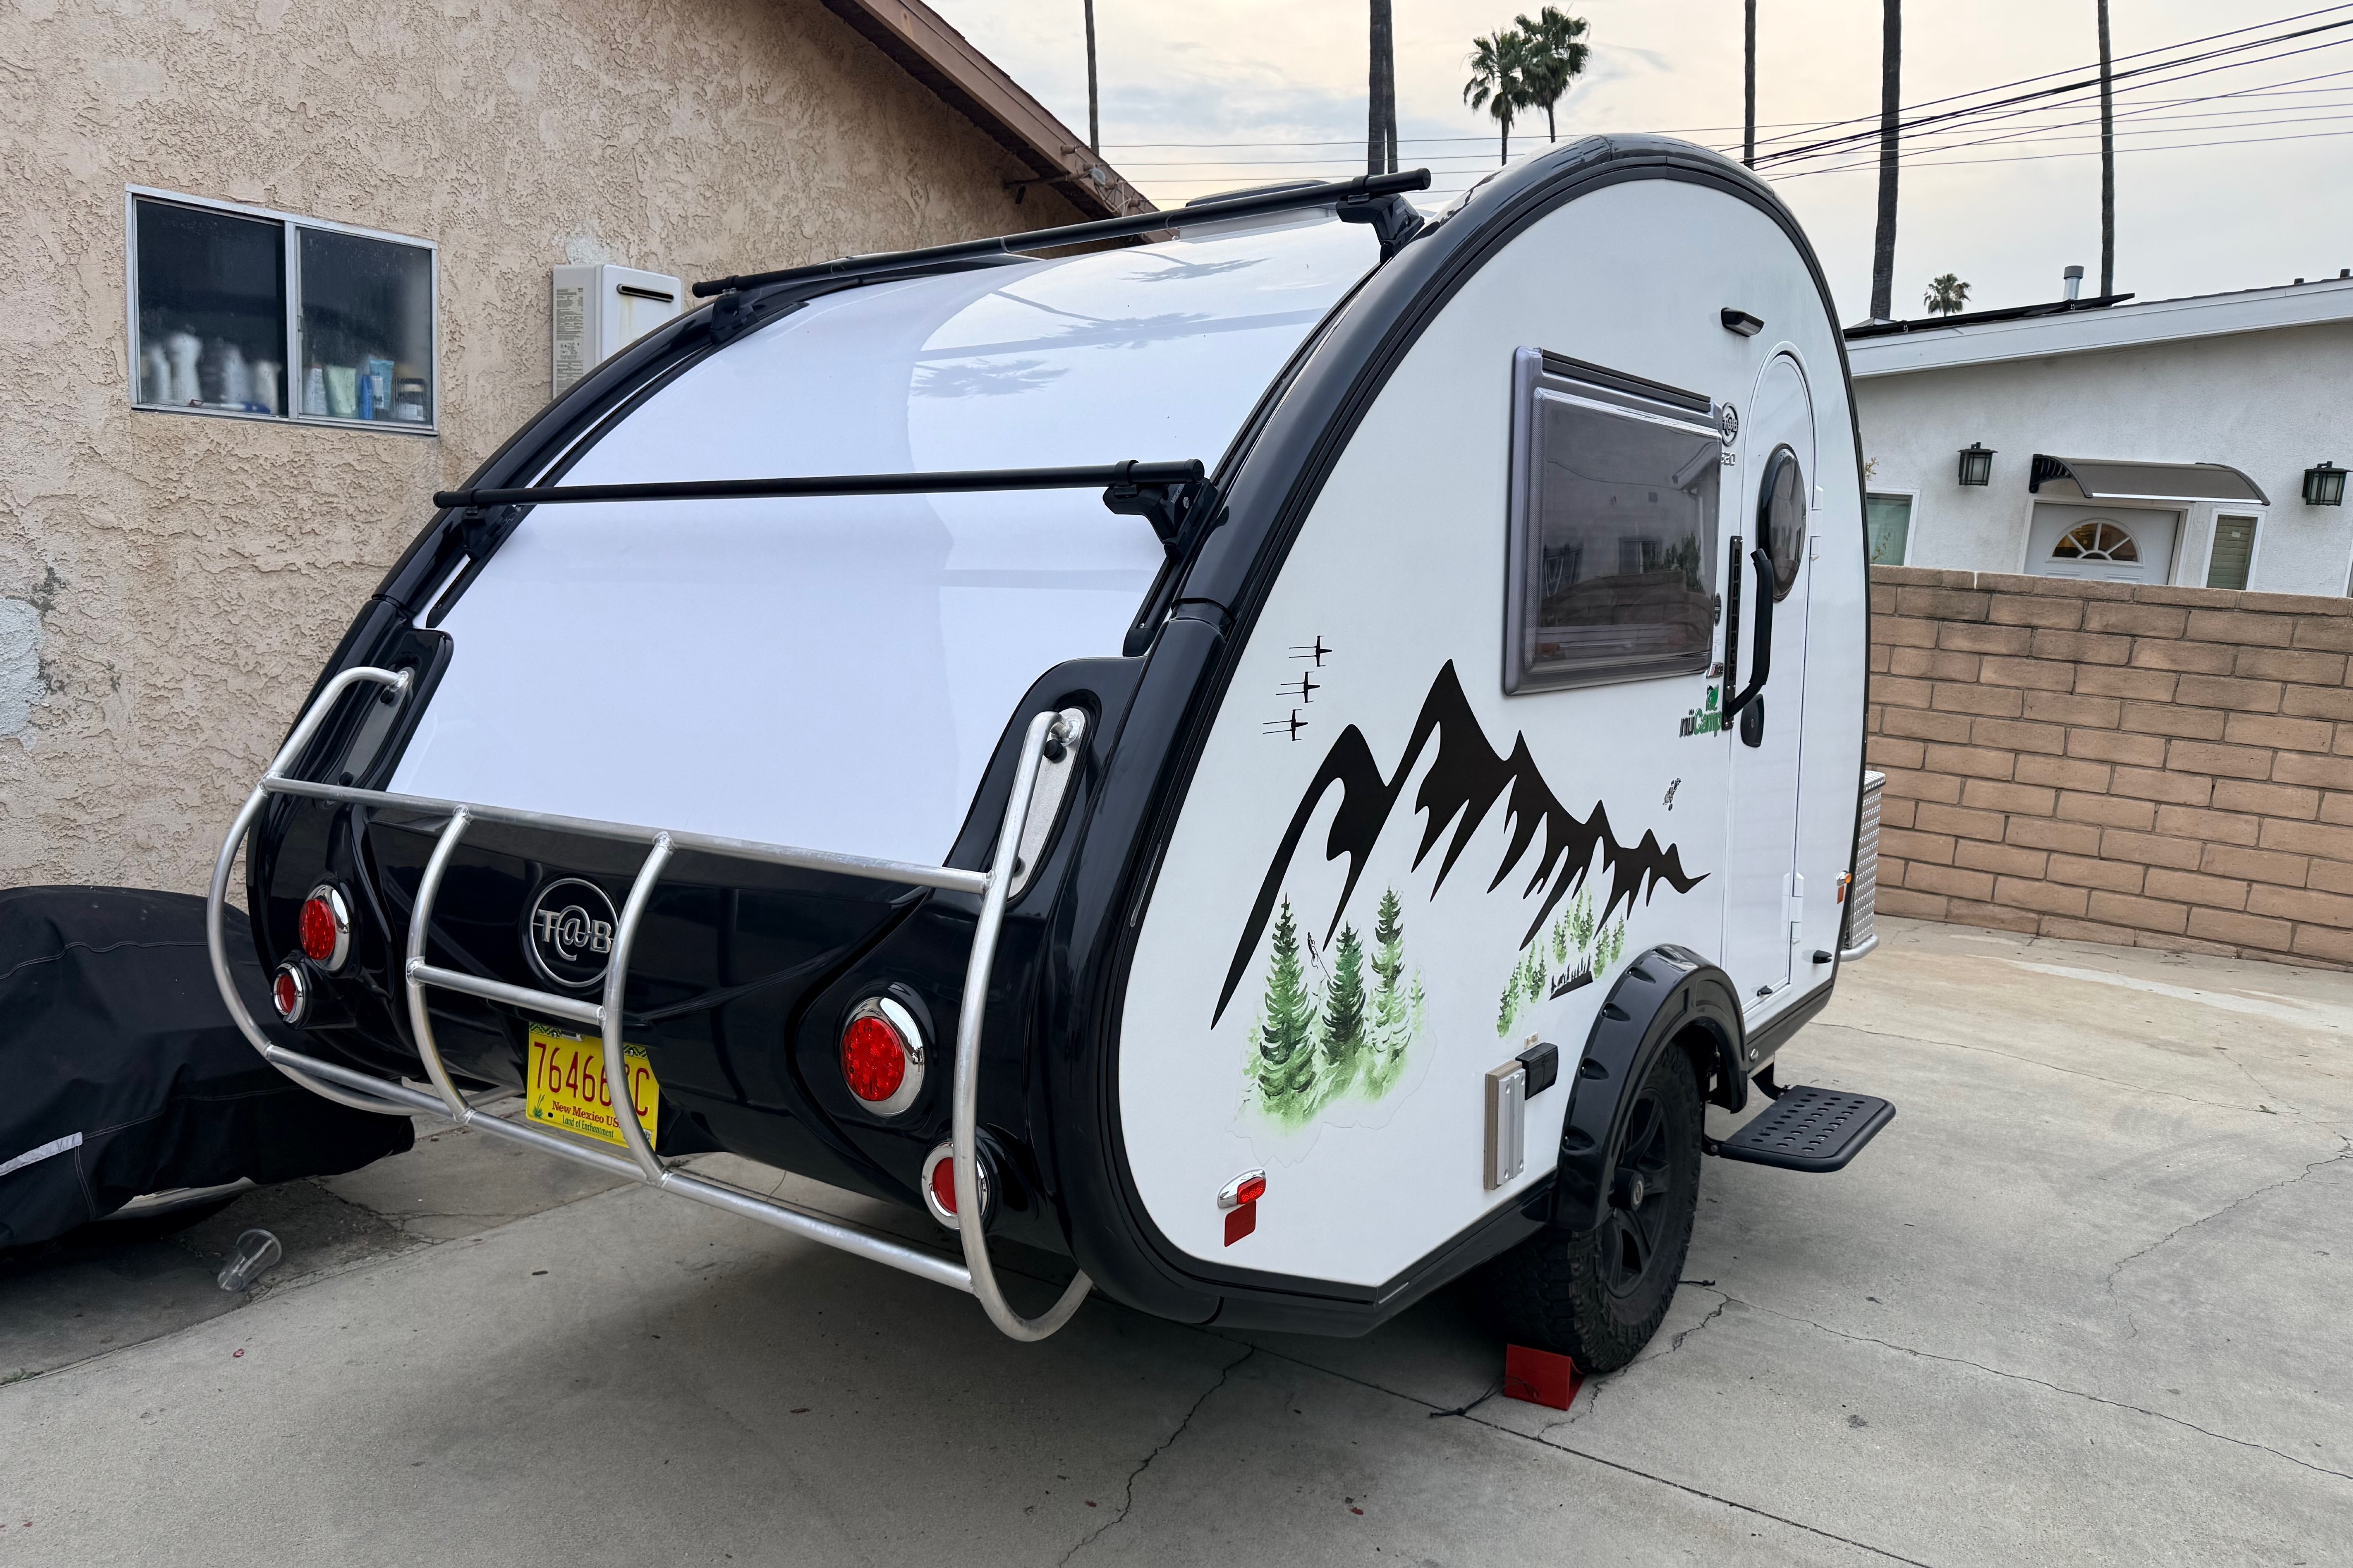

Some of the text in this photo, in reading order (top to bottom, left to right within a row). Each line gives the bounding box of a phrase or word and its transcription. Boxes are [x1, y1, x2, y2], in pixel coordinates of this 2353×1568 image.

[537, 904, 613, 961] T@B
[534, 1042, 650, 1117] 76466C
[552, 1100, 620, 1128] New Mexico US
[563, 1114, 614, 1138] Land of Enchantment
